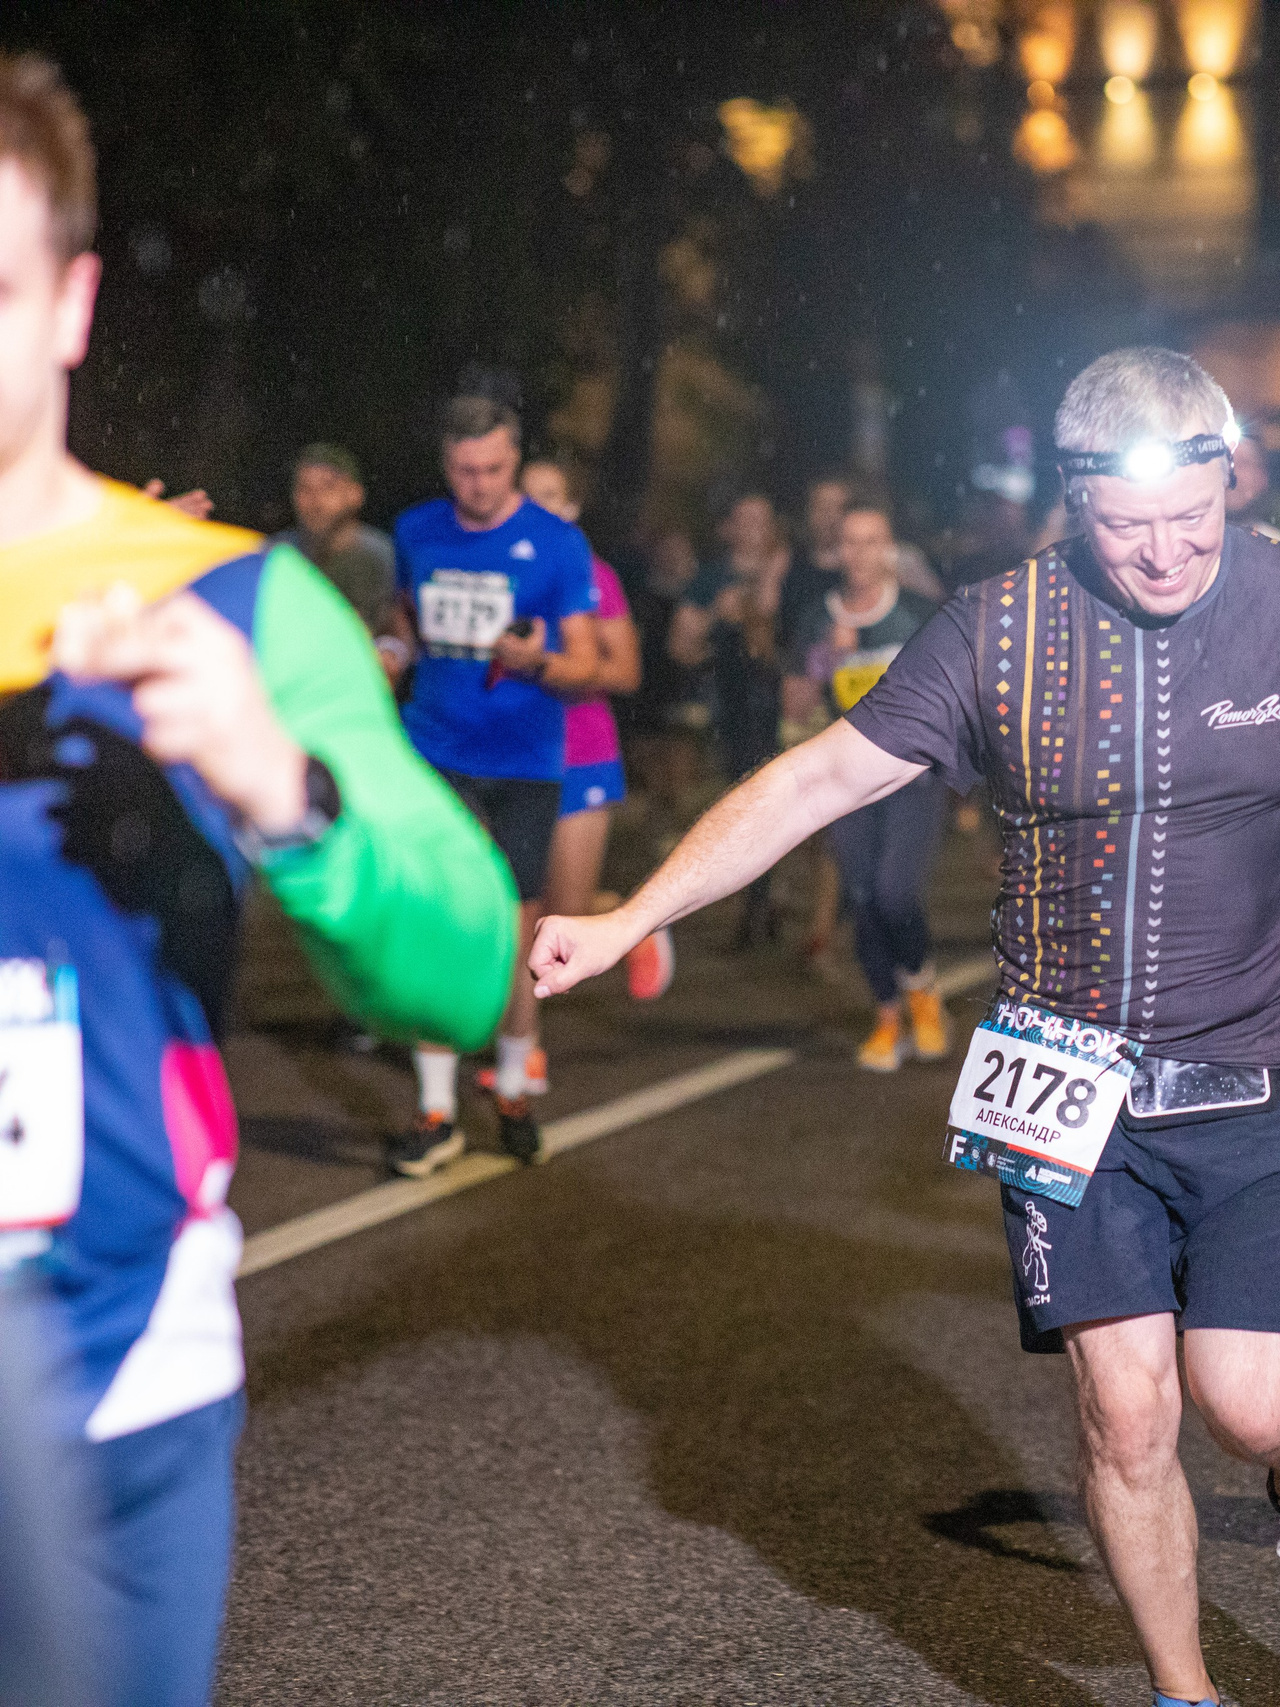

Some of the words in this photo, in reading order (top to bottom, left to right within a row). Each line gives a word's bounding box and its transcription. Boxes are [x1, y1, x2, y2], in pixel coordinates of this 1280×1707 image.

[973, 1049, 1098, 1129] 2178
[975, 1108, 1062, 1144] АЛЕКСАНДР
[949, 1134, 967, 1163] F
